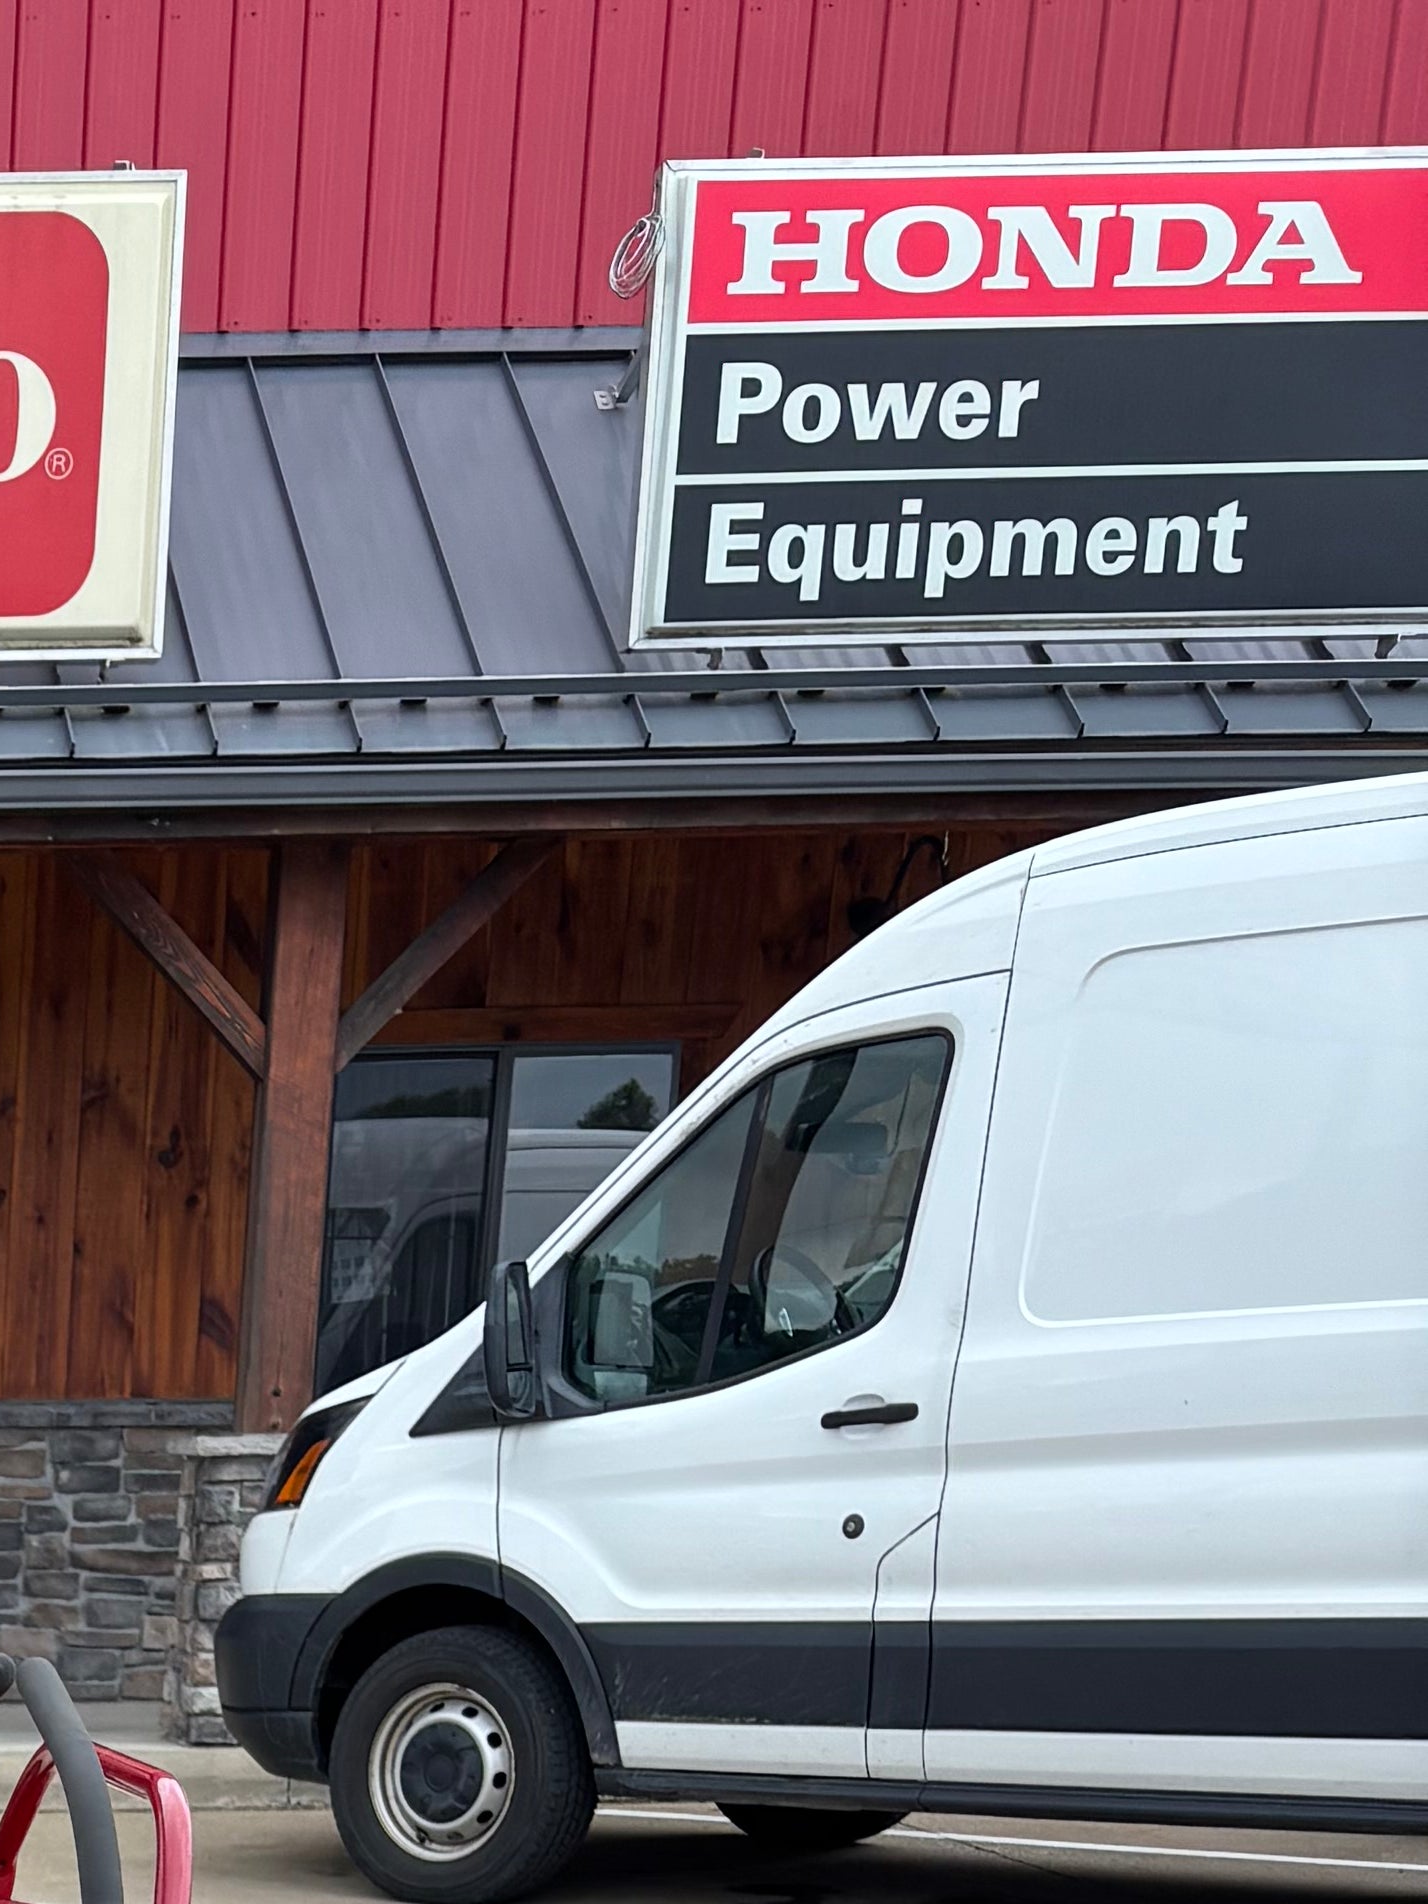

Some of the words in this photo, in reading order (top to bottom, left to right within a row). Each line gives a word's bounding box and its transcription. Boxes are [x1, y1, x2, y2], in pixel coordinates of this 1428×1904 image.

[726, 201, 1362, 295] HONDA
[716, 362, 1040, 444] Power
[705, 498, 1248, 601] Equipment
